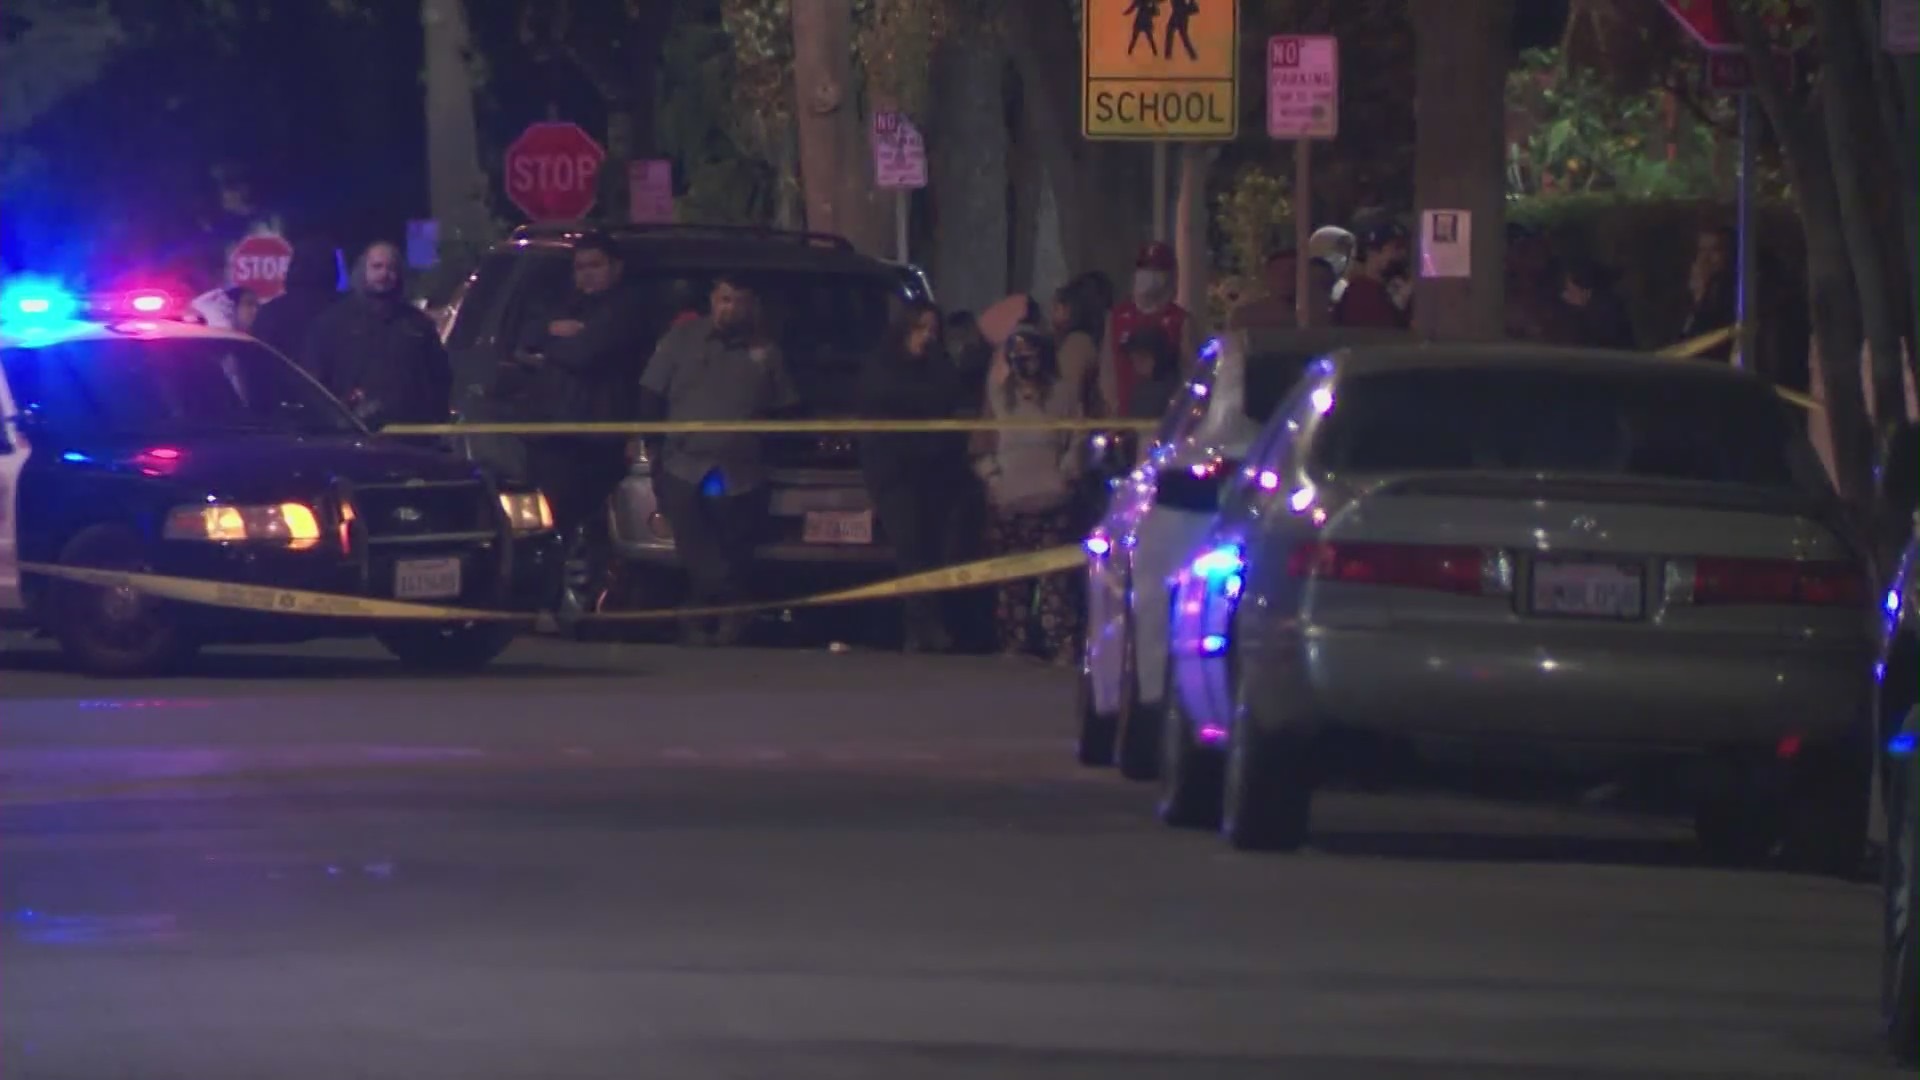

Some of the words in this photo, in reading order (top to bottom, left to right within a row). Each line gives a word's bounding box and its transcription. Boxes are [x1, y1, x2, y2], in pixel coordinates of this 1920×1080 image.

[1273, 43, 1297, 64] NO
[1096, 92, 1224, 123] SCHOOL
[878, 114, 896, 130] NO
[513, 155, 596, 192] STOP
